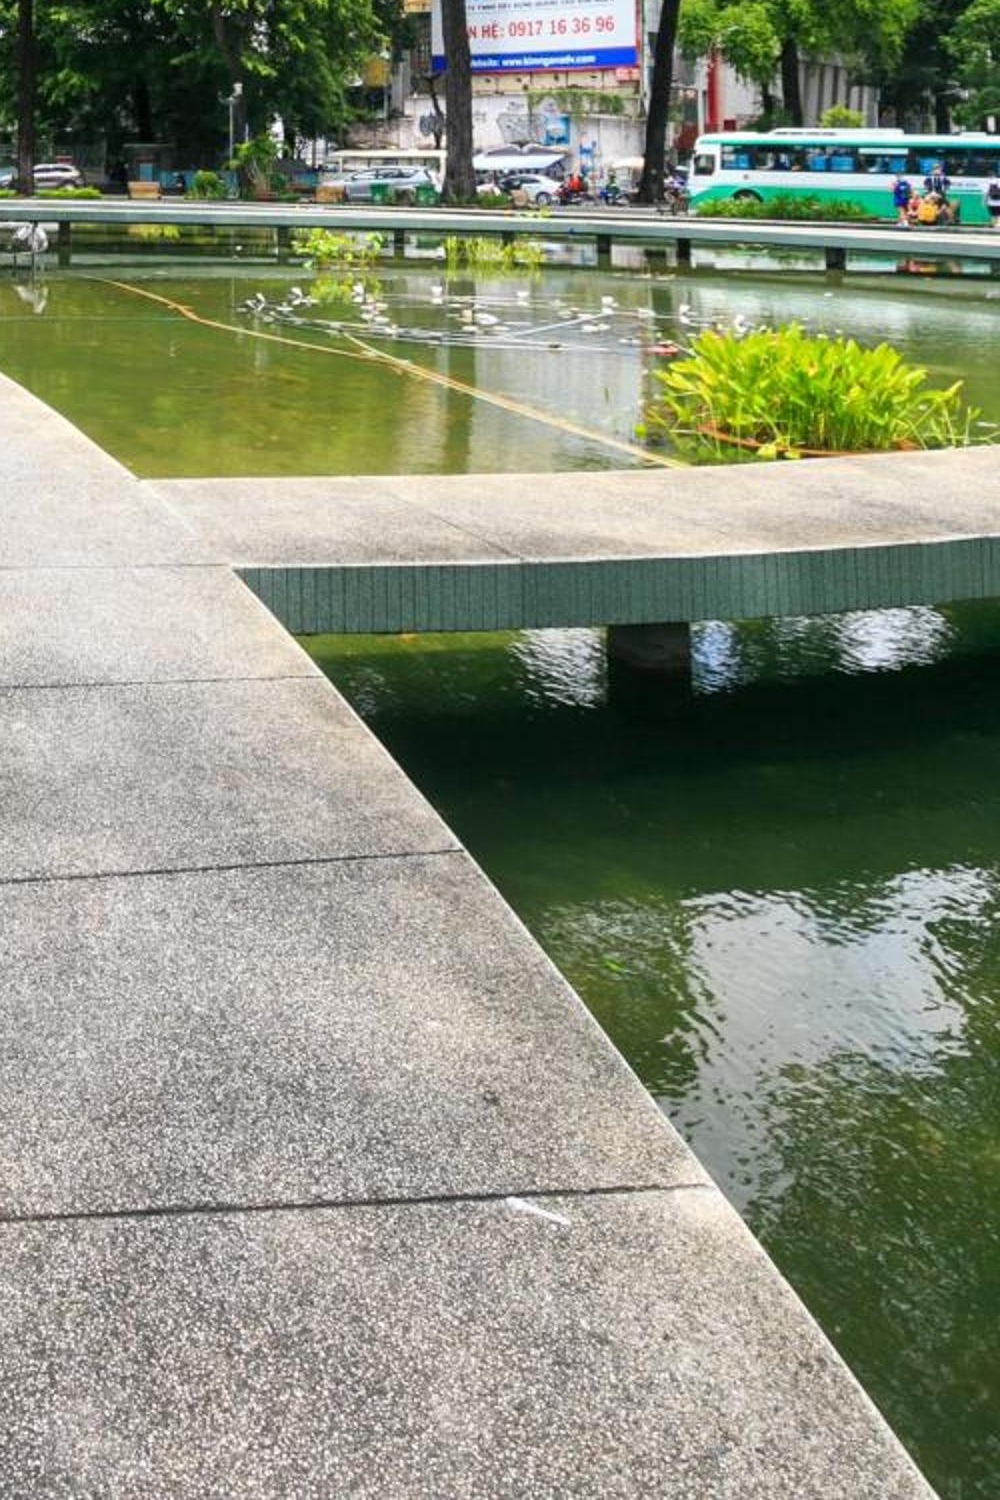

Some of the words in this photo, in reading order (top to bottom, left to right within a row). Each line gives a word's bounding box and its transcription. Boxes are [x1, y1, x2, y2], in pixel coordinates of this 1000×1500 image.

[508, 20, 544, 37] 0917
[551, 18, 567, 35] 16
[572, 17, 591, 34] 36
[595, 15, 615, 32] 96
